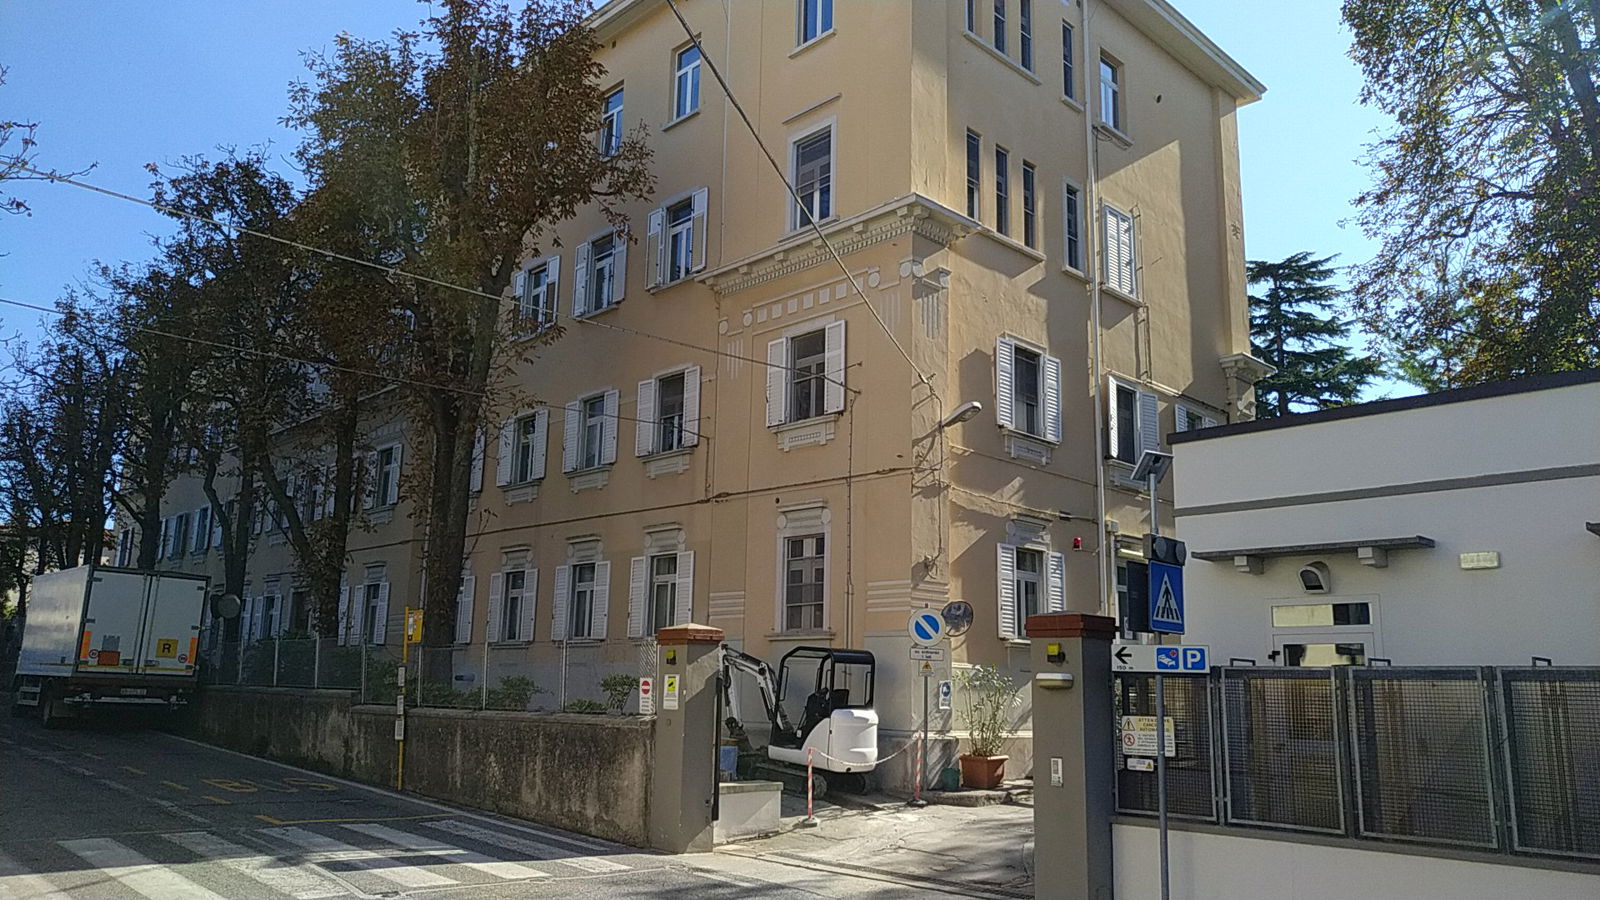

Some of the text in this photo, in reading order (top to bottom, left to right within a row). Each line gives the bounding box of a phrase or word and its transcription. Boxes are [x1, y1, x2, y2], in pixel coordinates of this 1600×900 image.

[162, 643, 171, 653] R
[1186, 650, 1201, 668] P
[200, 777, 338, 792] BUS
